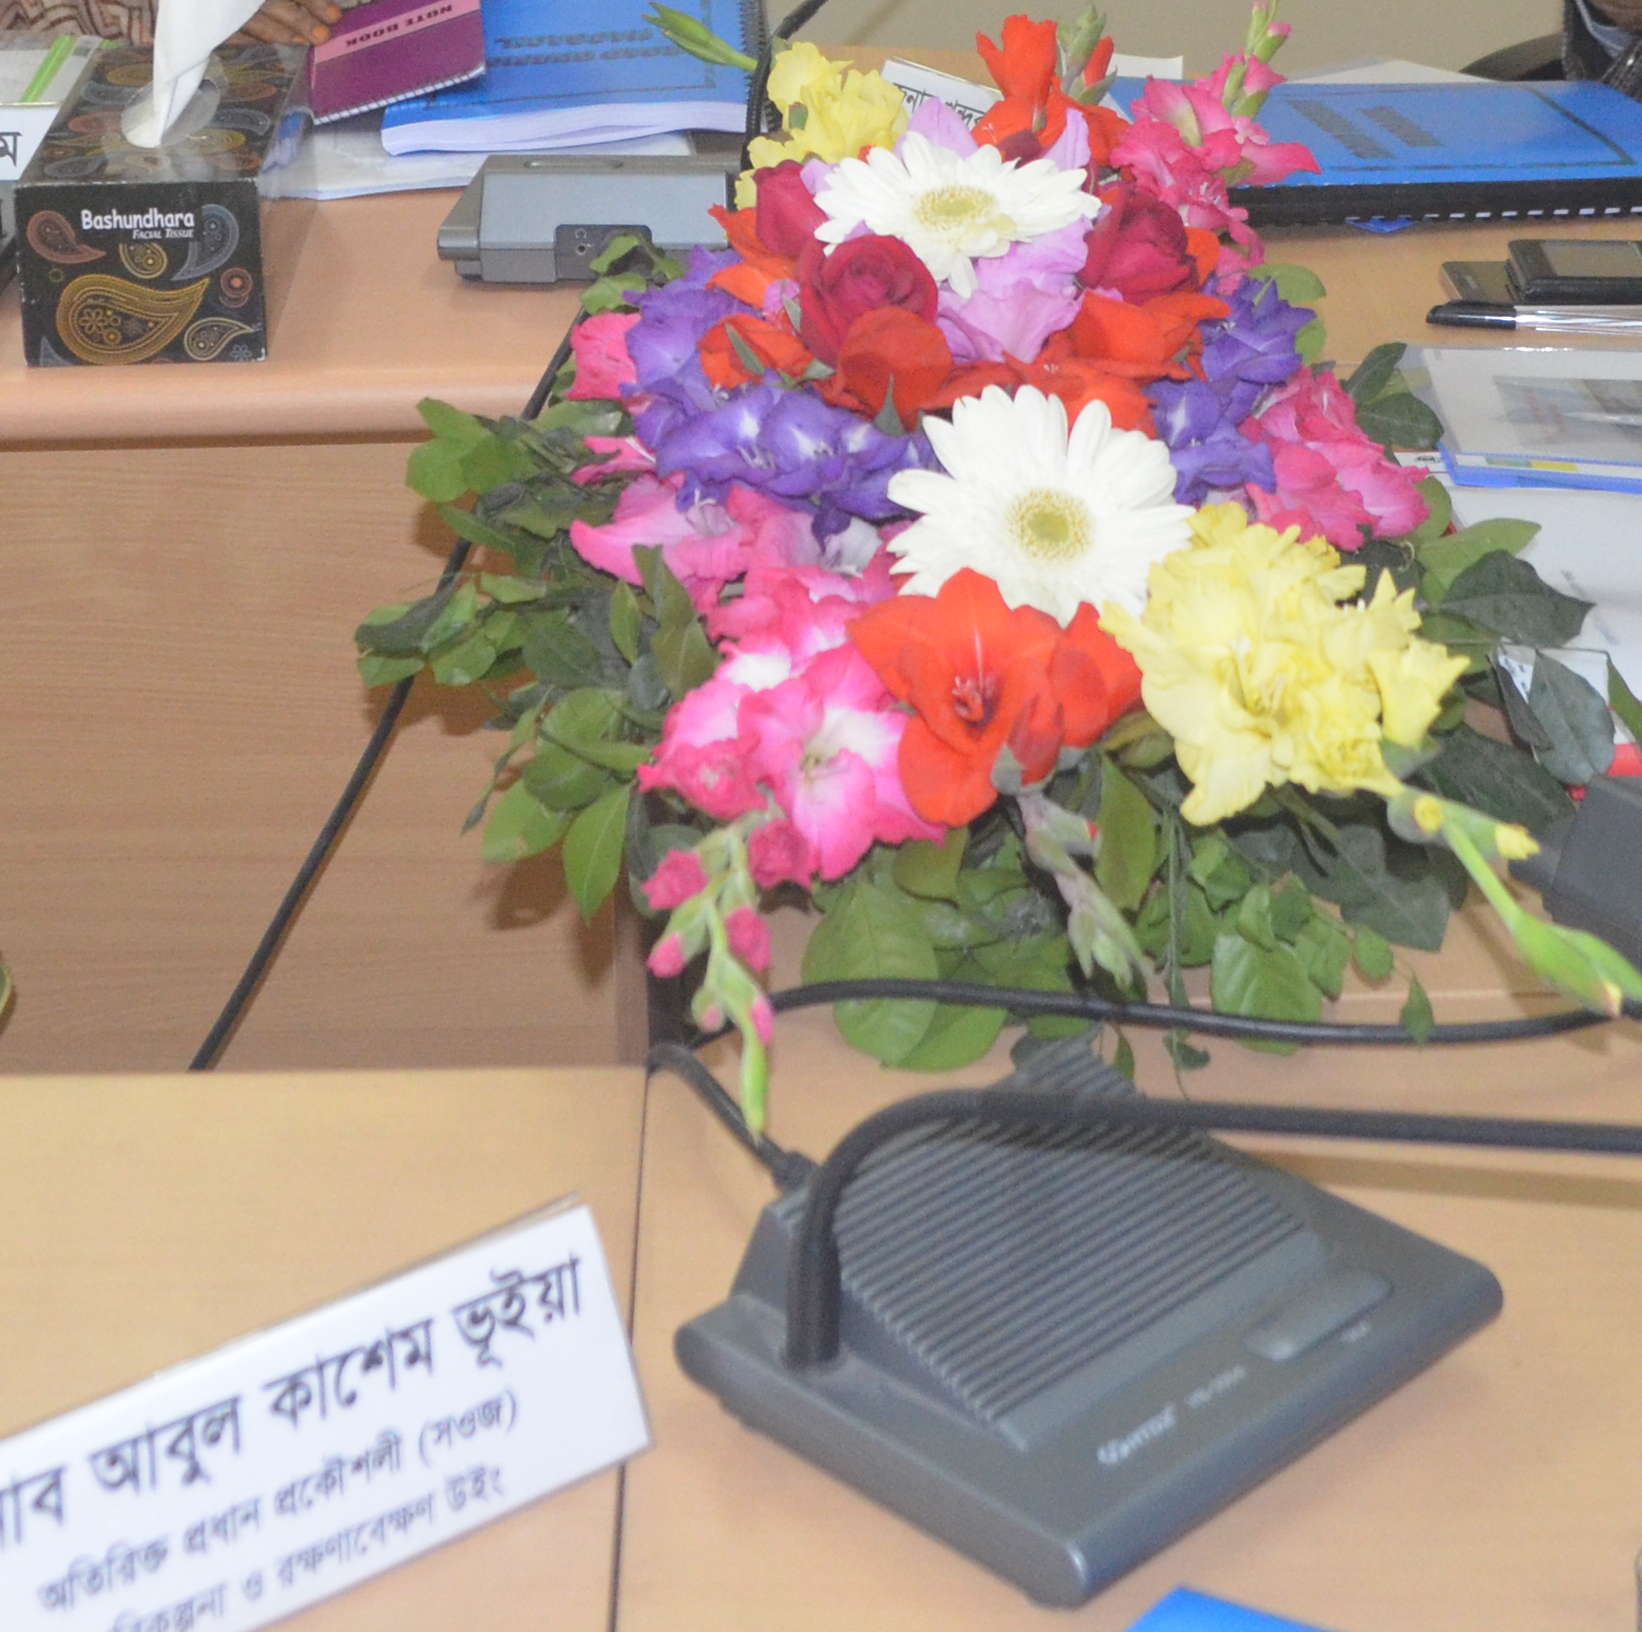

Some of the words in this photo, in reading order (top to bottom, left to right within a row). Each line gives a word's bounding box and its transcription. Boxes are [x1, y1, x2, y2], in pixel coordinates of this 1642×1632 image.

[345, 22, 399, 47] BOOK
[404, 4, 453, 27] NOTE
[81, 208, 195, 230] Bashundhara
[88, 1393, 243, 1496] আবুল
[262, 1318, 436, 1430] কাশেম
[37, 1533, 170, 1611] অতিরিক্ত
[182, 1496, 261, 1555] প্রধান
[273, 1427, 403, 1517] প্রকৌশলী
[419, 1388, 517, 1468] (সওজ)
[242, 1568, 264, 1603] ও
[445, 1463, 504, 1512] উইং
